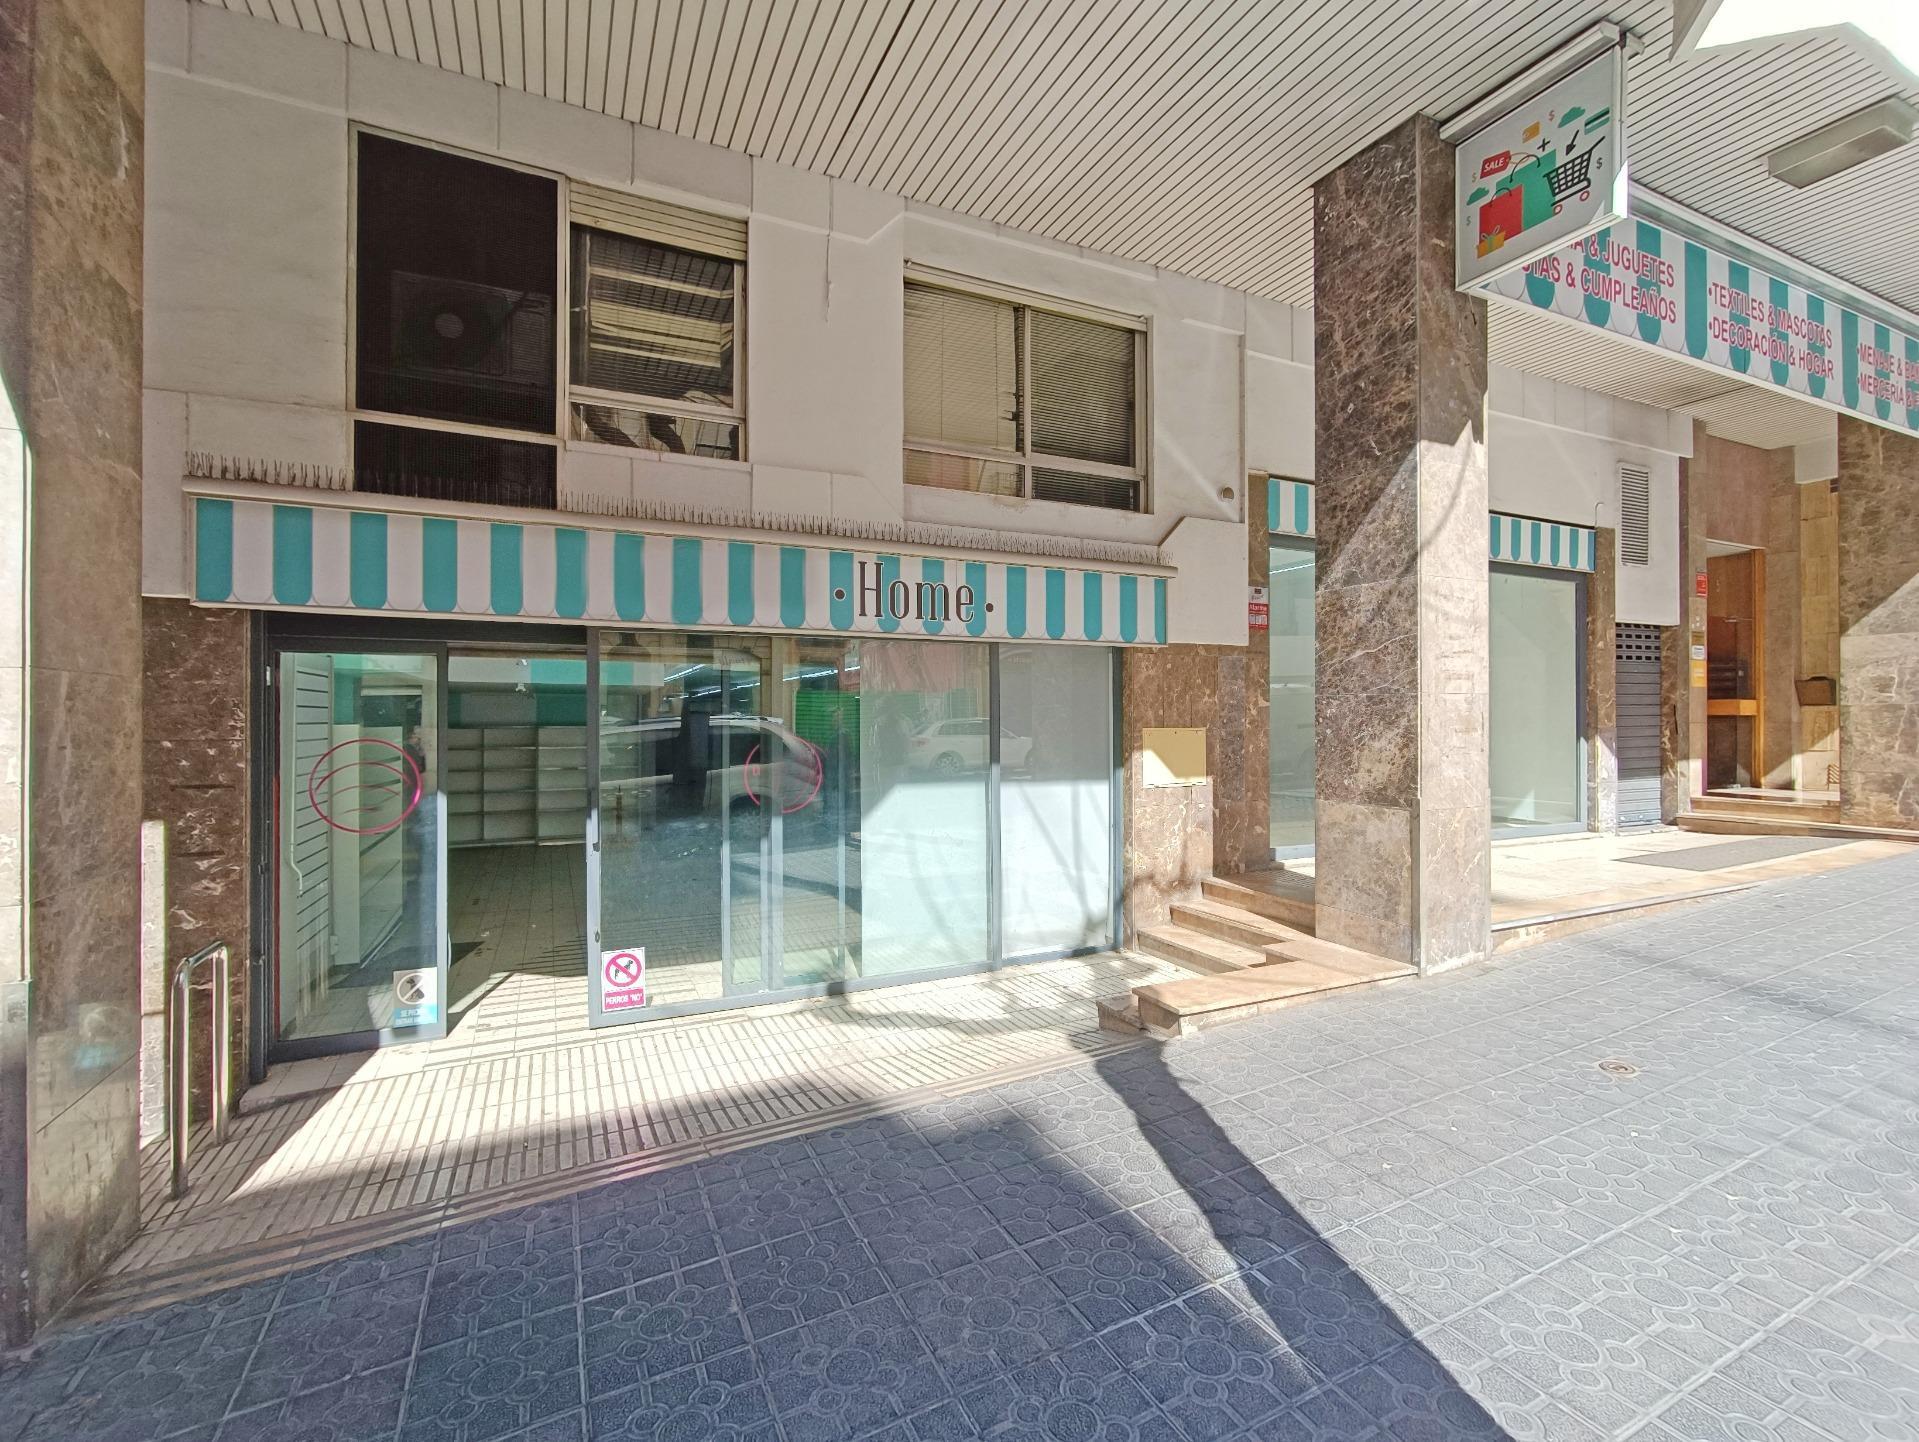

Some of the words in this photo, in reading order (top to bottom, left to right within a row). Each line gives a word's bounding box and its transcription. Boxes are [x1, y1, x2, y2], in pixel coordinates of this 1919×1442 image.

[1483, 157, 1504, 172] SALE
[1590, 233, 1598, 258] &
[1603, 239, 1674, 288] JUGUETES
[1565, 262, 1576, 288] &
[1580, 267, 1677, 324] CUMPLEAÑOS
[1767, 304, 1775, 327] &
[1777, 309, 1832, 349] MASCOTAS
[1788, 345, 1796, 366] &
[1798, 348, 1834, 380] HOGAR
[858, 561, 974, 623] Home
[605, 995, 629, 1005] PERROS
